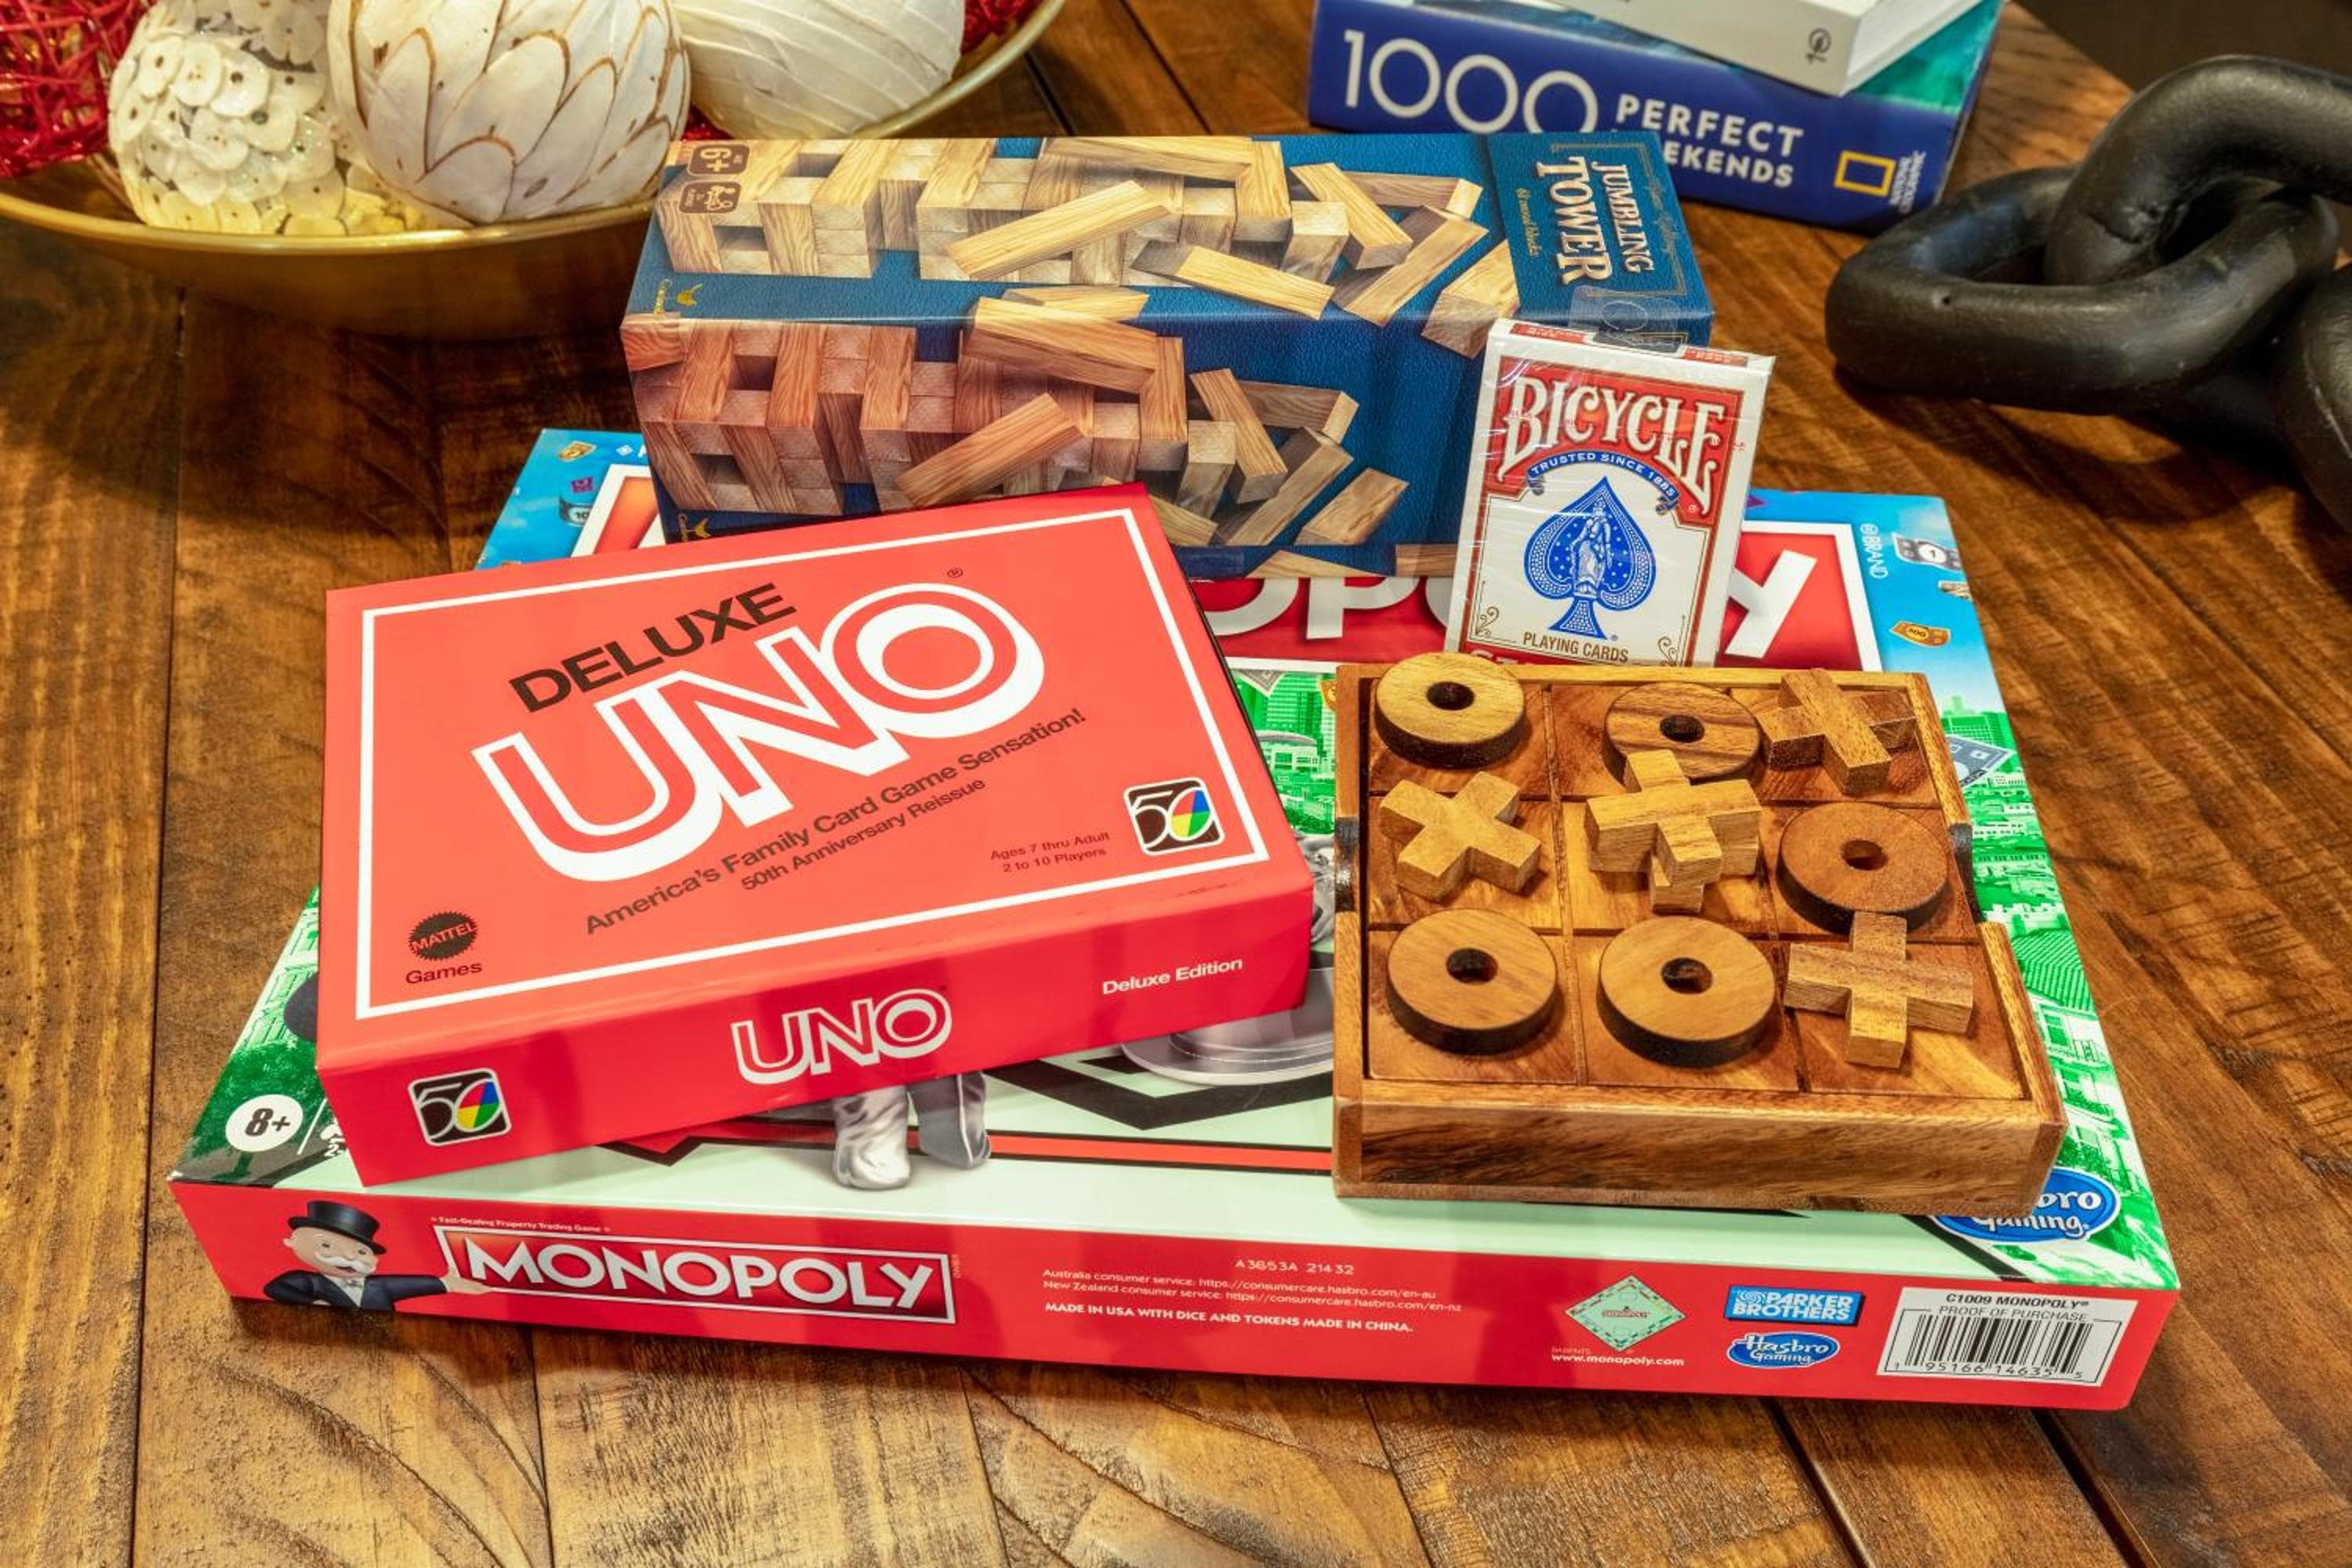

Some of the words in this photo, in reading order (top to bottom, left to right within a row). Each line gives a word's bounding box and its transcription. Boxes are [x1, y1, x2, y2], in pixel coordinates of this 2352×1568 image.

[1344, 31, 1599, 134] 1000
[1616, 93, 1803, 157] PERFECT
[700, 147, 732, 172] 6+
[1664, 142, 1794, 187] EKENDS
[1536, 156, 1612, 285] TOWER
[1592, 161, 1654, 274] JUMBLING
[1496, 376, 1725, 515] BICYCLE
[1531, 452, 1596, 474] TRUSTED
[1601, 452, 1646, 474] SINCE
[1648, 471, 1675, 497] 1885
[508, 583, 797, 713] DELUXE
[1523, 632, 1580, 655] PLAYING
[1583, 642, 1629, 663] CARDS
[470, 583, 1045, 882] UNO
[587, 868, 720, 935] America's
[721, 828, 810, 874] Family
[812, 796, 879, 833] Card
[880, 764, 958, 804] Game
[957, 707, 1087, 771] Sensation!
[741, 862, 789, 891] 50th
[793, 812, 906, 870] Anniversary
[907, 779, 986, 818] Reissue
[990, 848, 1026, 860] Ages
[1030, 844, 1037, 853] 7
[1042, 840, 1070, 851] thru
[1073, 831, 1110, 845] Adult
[1003, 863, 1011, 873] 2
[1015, 860, 1029, 870] to
[1035, 856, 1051, 866] 10
[1054, 848, 1107, 863] Players
[412, 922, 477, 953] MATTEL
[405, 963, 483, 984] Games
[1102, 972, 1171, 995] Deluxe
[1175, 959, 1243, 982] Edition
[730, 988, 953, 1085] UNO
[245, 1108, 290, 1137] 8+
[496, 1220, 537, 1230] Property
[538, 1222, 573, 1232] Trading
[464, 1236, 934, 1309] MONOPOLY
[1042, 1269, 1091, 1280] Australia
[1094, 1272, 1149, 1284] consumer
[1152, 1277, 1196, 1287] service:
[1043, 1280, 1069, 1290] New
[1073, 1282, 1119, 1293] Zealand
[1121, 1286, 1177, 1298] consumer
[1179, 1290, 1224, 1300] service:
[1766, 1291, 1853, 1309] PARKER
[1946, 1294, 1992, 1305] C1009
[1045, 1303, 1084, 1313] MADE
[1088, 1305, 1103, 1314] IN
[1106, 1306, 1135, 1316] USA
[1138, 1308, 1174, 1319] WITH
[1176, 1311, 1207, 1321] DICE
[1209, 1313, 1240, 1323] AND
[1243, 1314, 1300, 1327] TOKENS
[1303, 1318, 1343, 1328] MADE
[1346, 1319, 1362, 1329] IN
[1365, 1321, 1414, 1332] CHINA.
[1732, 1303, 1851, 1320] BROTHERS
[1939, 1305, 1987, 1316] PROOF
[1990, 1308, 2008, 1317] OF
[2011, 1309, 2087, 1322] PURCHASE
[1735, 1334, 1830, 1354] Hasbro
[1749, 1350, 1815, 1365] Gaming
[1552, 1354, 1685, 1367] www.monopoly.com
[1926, 1363, 1984, 1373] 95166
[1996, 1366, 2053, 1377] 14635
